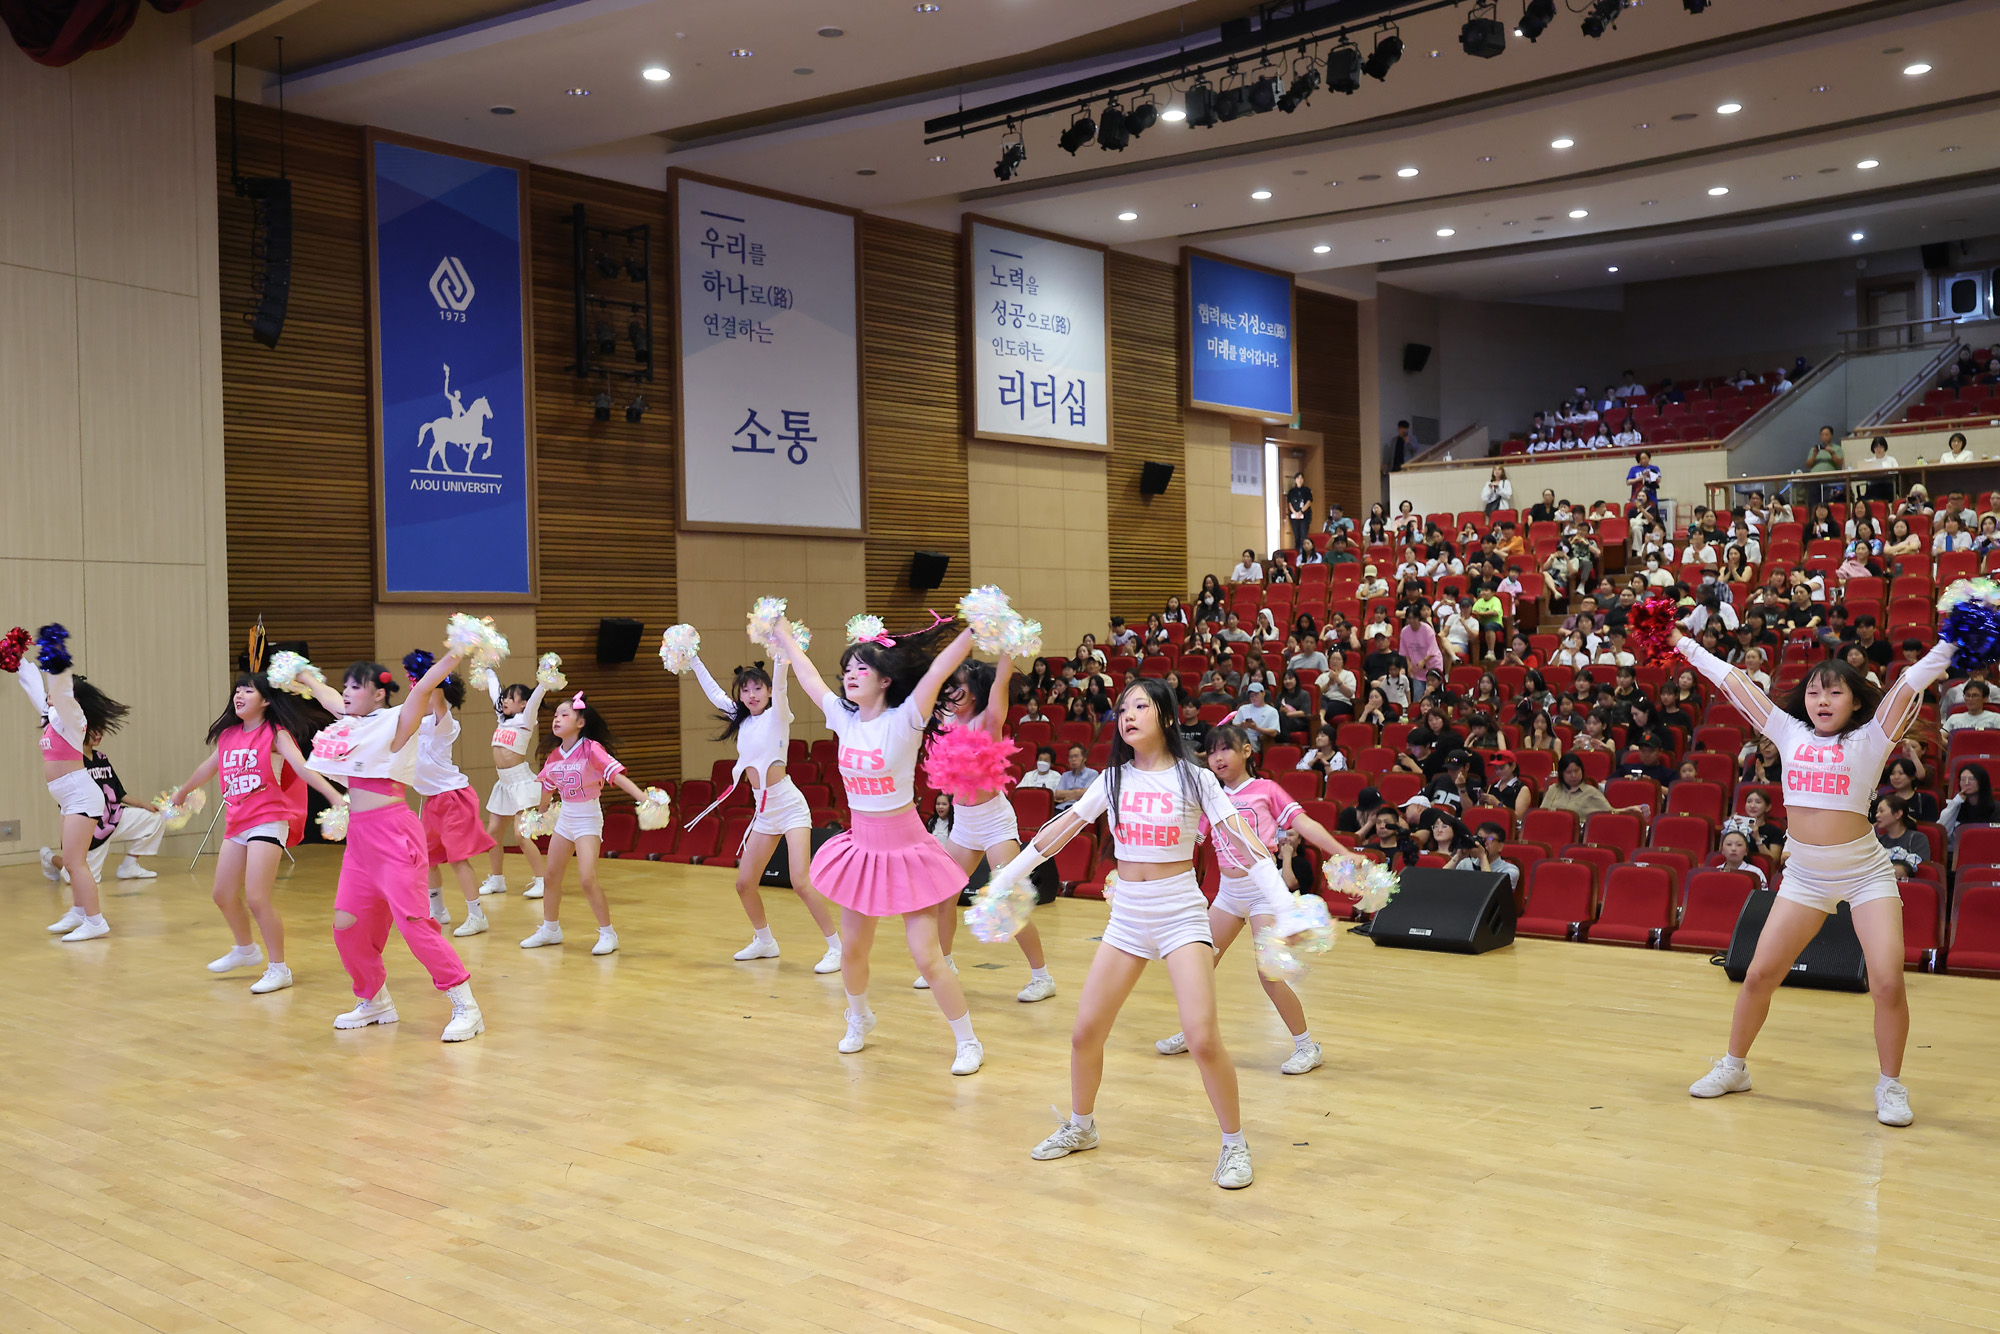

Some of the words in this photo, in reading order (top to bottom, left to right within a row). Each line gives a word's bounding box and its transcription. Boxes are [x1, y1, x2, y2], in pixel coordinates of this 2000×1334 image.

[700, 227, 767, 266] 우리를
[701, 269, 794, 310] 하나로(路)
[989, 264, 1039, 296] 노력을
[439, 310, 467, 323] 1973
[703, 313, 774, 344] 연결하는
[991, 299, 1071, 335] 성공으로(路)
[1198, 303, 1237, 330] 협력하는
[992, 336, 1045, 362] 인도하는
[1207, 336, 1238, 361] 미래를
[1239, 346, 1279, 369] 열어갑니다.
[998, 369, 1087, 427] 리더십
[731, 407, 818, 465] 소통
[410, 479, 440, 491] AJOU
[442, 481, 503, 494] UNIVERSITY
[1793, 743, 1845, 763] LET'S
[1787, 770, 1850, 796] CHEER
[1121, 791, 1173, 814] LET'S
[1114, 822, 1181, 847] CHEER
